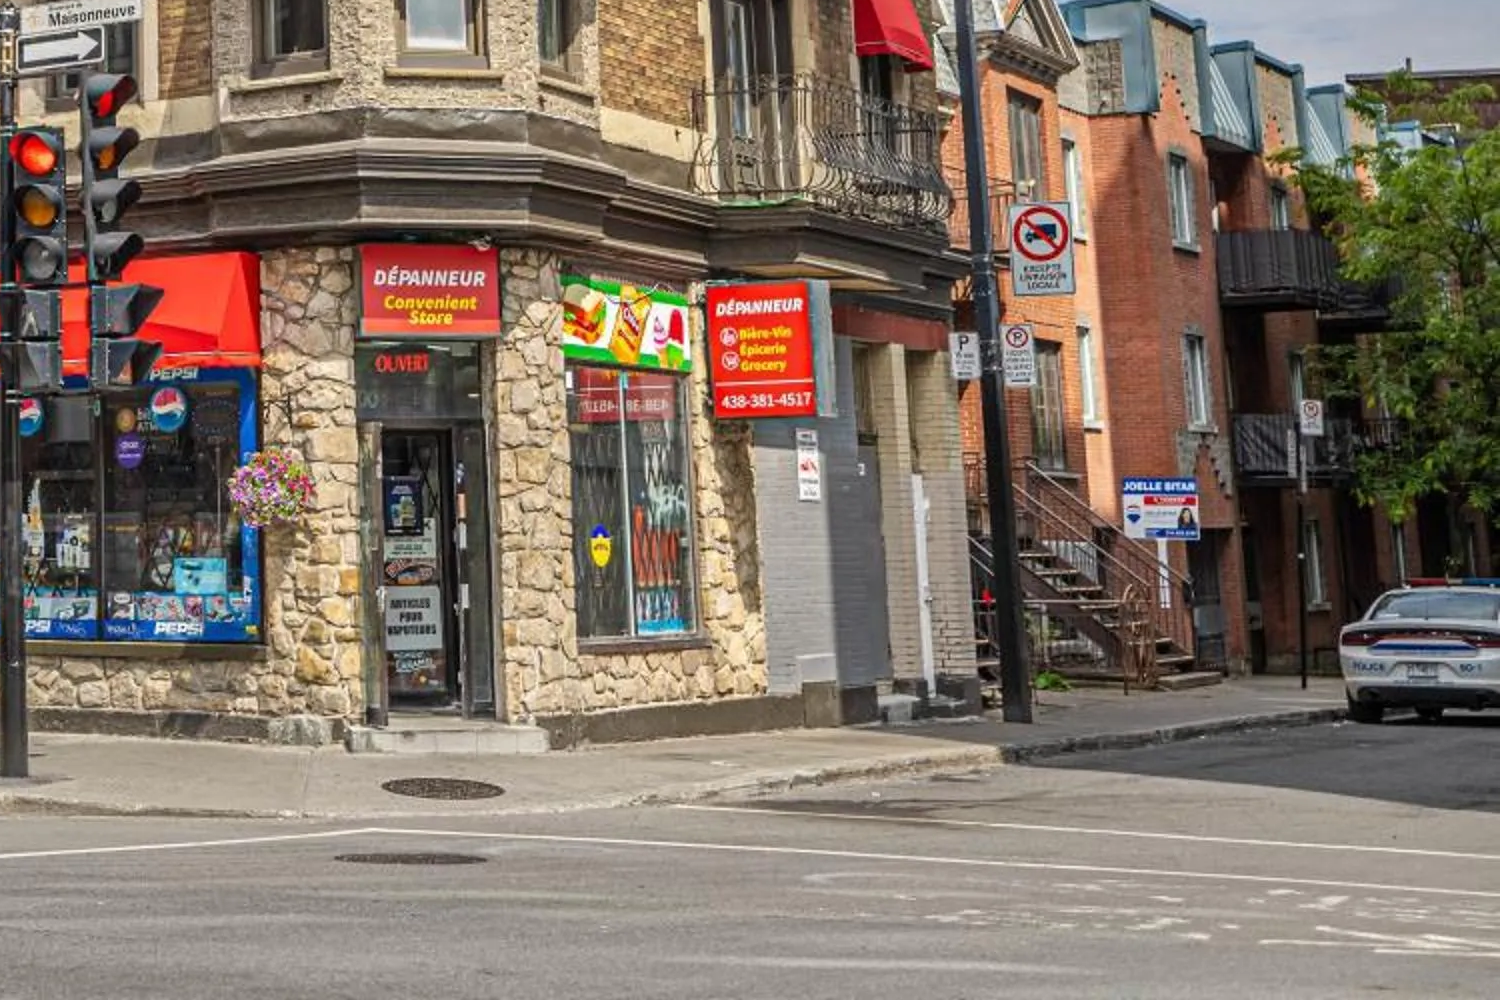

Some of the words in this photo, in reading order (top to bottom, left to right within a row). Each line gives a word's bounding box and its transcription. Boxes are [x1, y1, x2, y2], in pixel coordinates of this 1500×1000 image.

[49, 6, 136, 27] Maisonneuve
[373, 265, 486, 288] DÉPANNEUR
[383, 294, 478, 311] Convenient
[715, 297, 804, 318] DÉPANNEUR
[408, 310, 454, 326] Store
[739, 326, 793, 341] Bière-Vin
[739, 341, 788, 357] Épicerie
[374, 353, 430, 373] OUVERT
[740, 359, 788, 373] Grocery
[150, 366, 199, 382] PEPSI
[721, 391, 812, 409] 438-381-4517
[1123, 481, 1162, 492] JOELLE
[389, 597, 431, 609] ARTICLES
[399, 611, 424, 623] POUR
[24, 619, 51, 634] PSI
[154, 620, 204, 636] PEPSI
